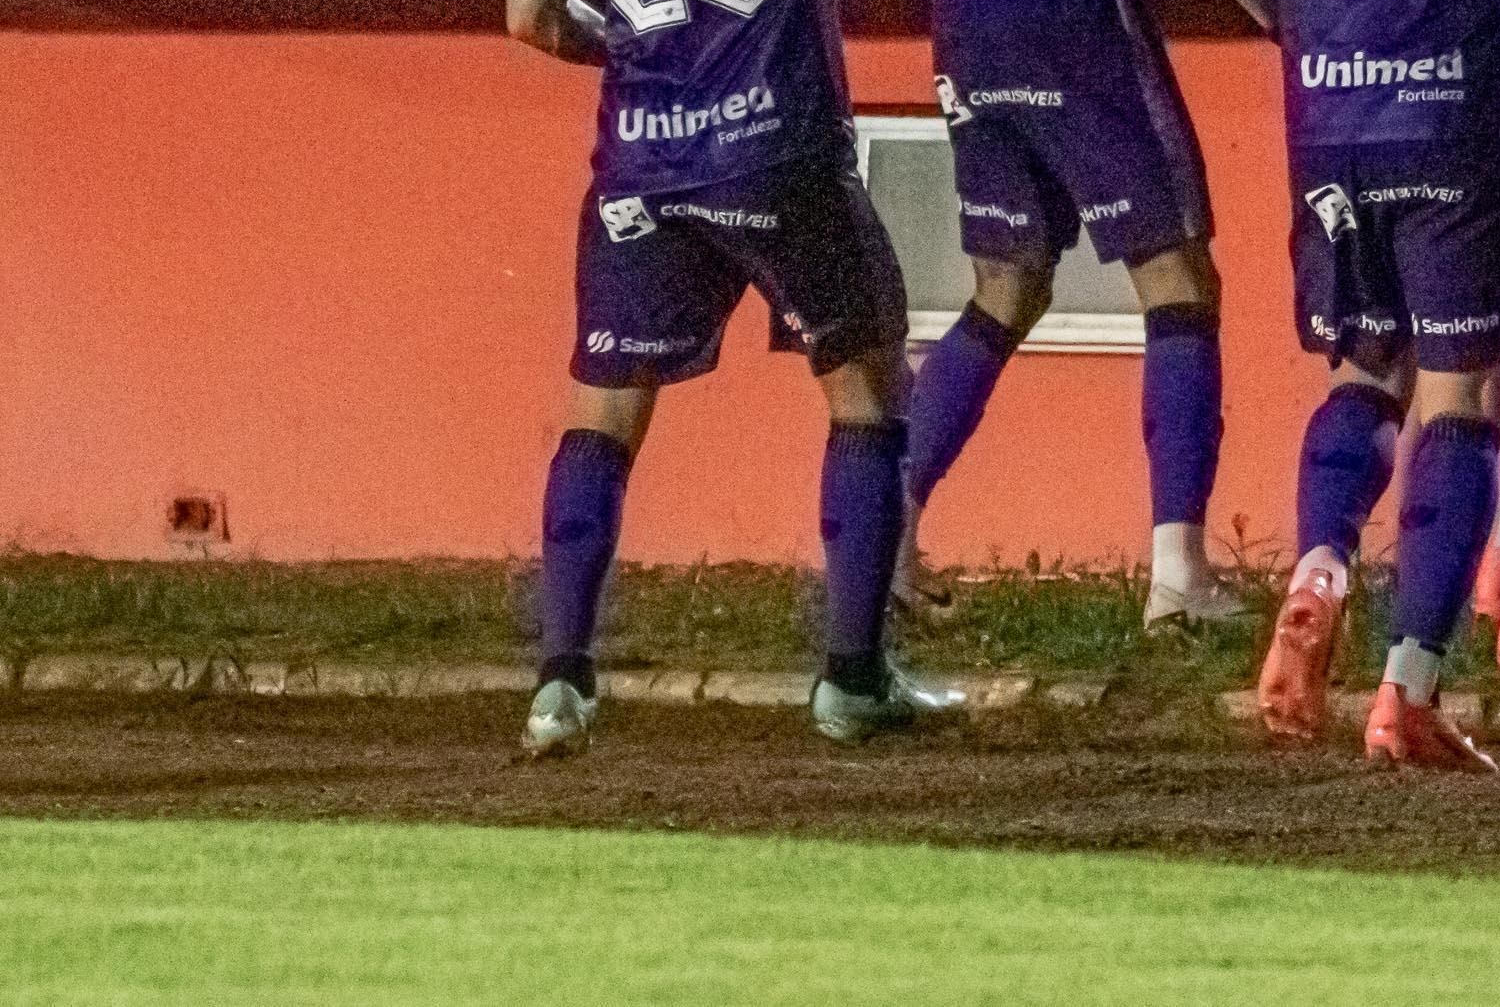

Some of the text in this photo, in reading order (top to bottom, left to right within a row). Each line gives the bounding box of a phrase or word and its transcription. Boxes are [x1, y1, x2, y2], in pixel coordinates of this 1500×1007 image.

[1300, 48, 1465, 89] Unimed
[1397, 87, 1466, 105] Fortaleza
[717, 117, 782, 146] Fortaleza
[1421, 312, 1500, 336] Sankhya
